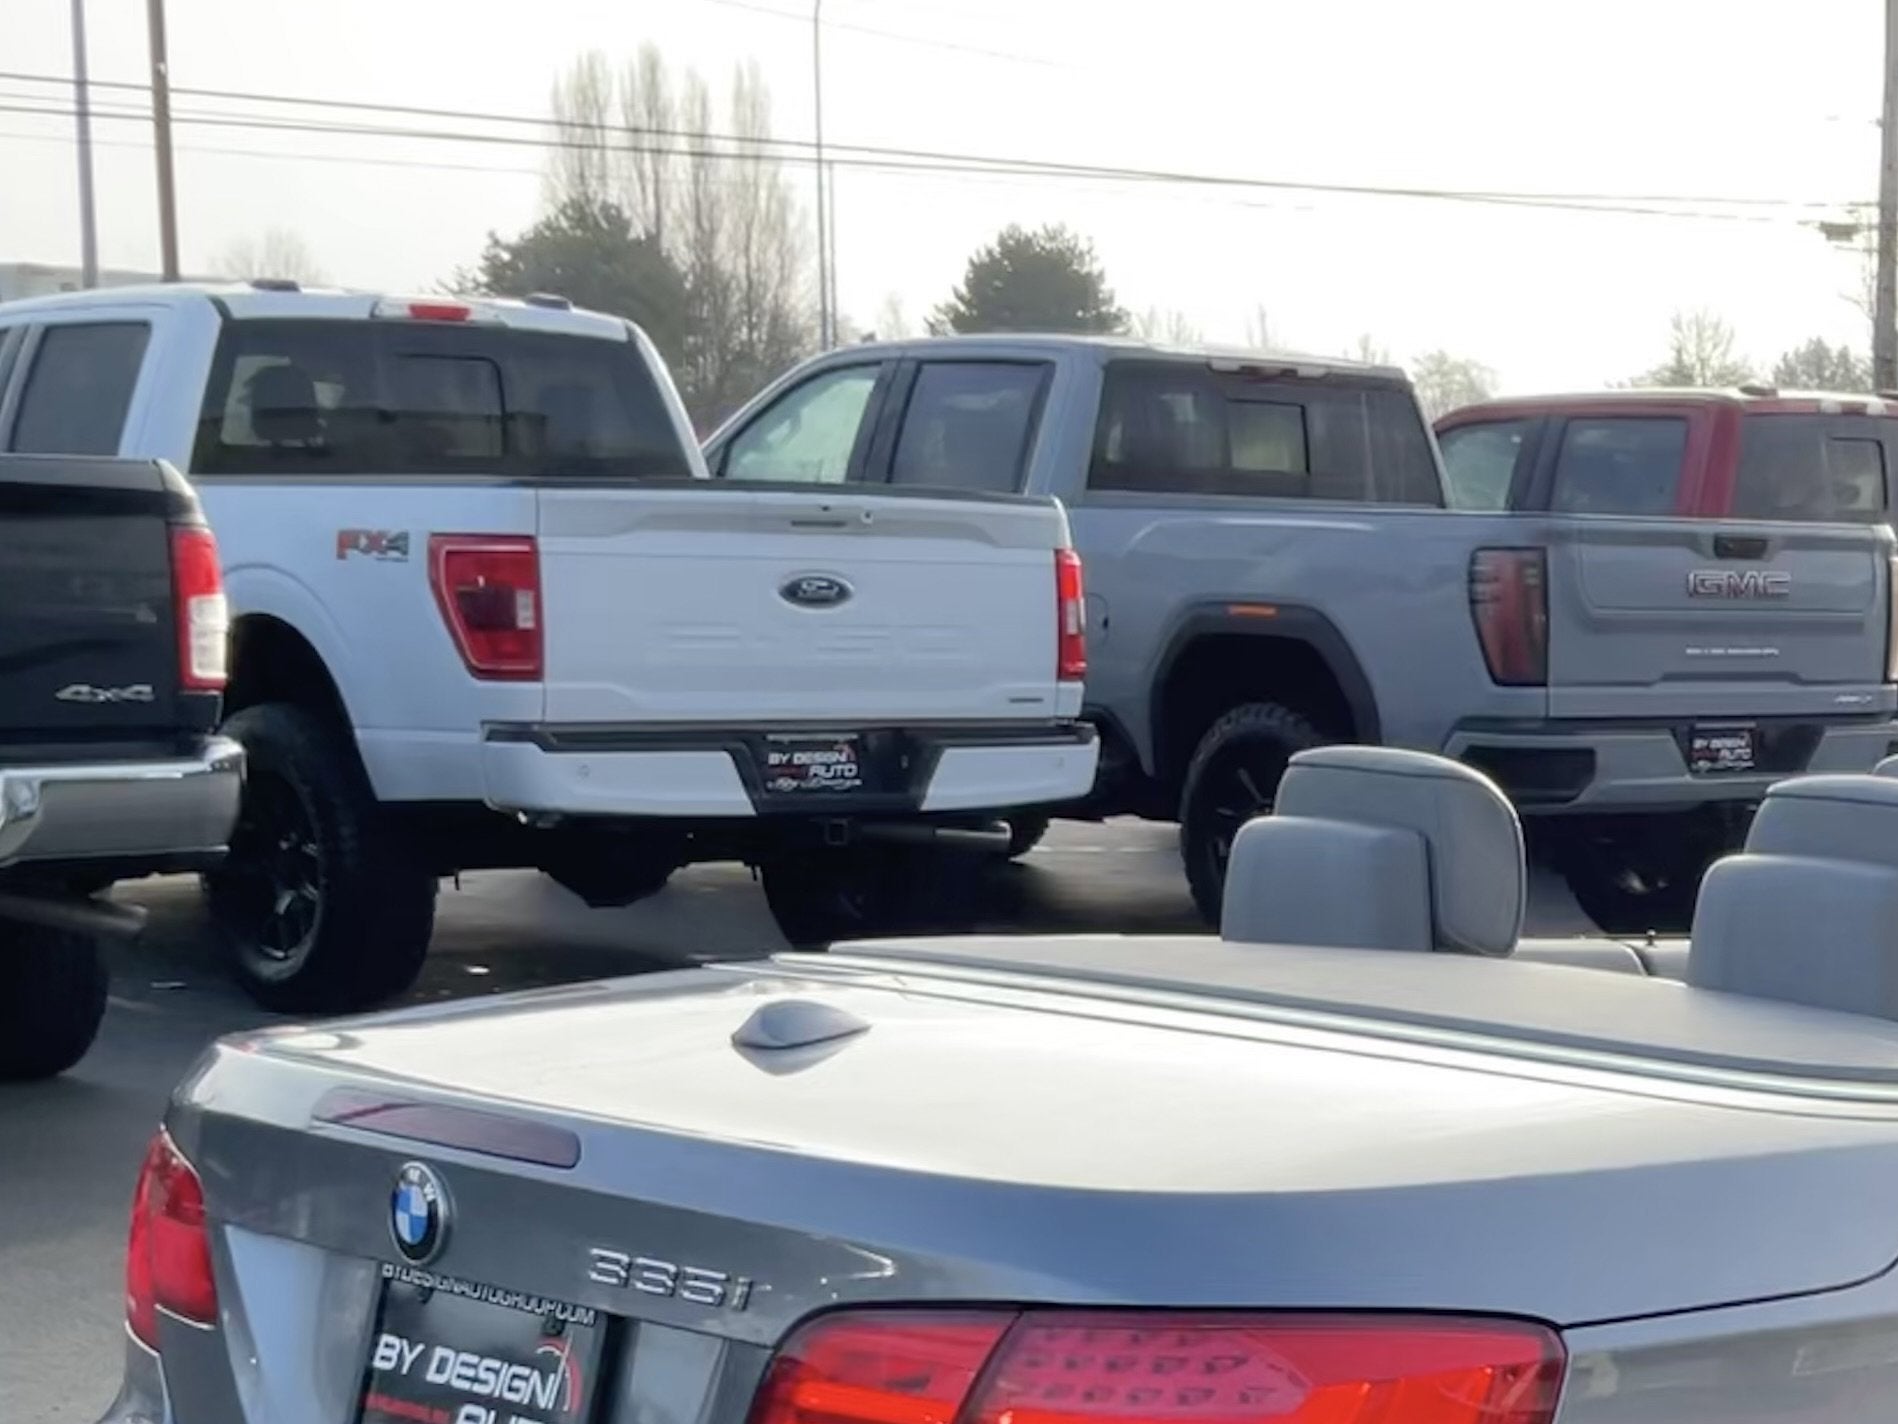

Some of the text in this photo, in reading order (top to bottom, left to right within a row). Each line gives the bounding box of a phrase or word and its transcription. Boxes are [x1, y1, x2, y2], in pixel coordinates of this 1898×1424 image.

[336, 529, 409, 560] FX4
[1687, 568, 1791, 599] GMC
[767, 751, 848, 765] BY DESIGN
[808, 763, 858, 778] AUTO
[587, 1247, 752, 1312] 335i
[371, 1333, 426, 1373] BY
[425, 1345, 560, 1412] DESIGN
